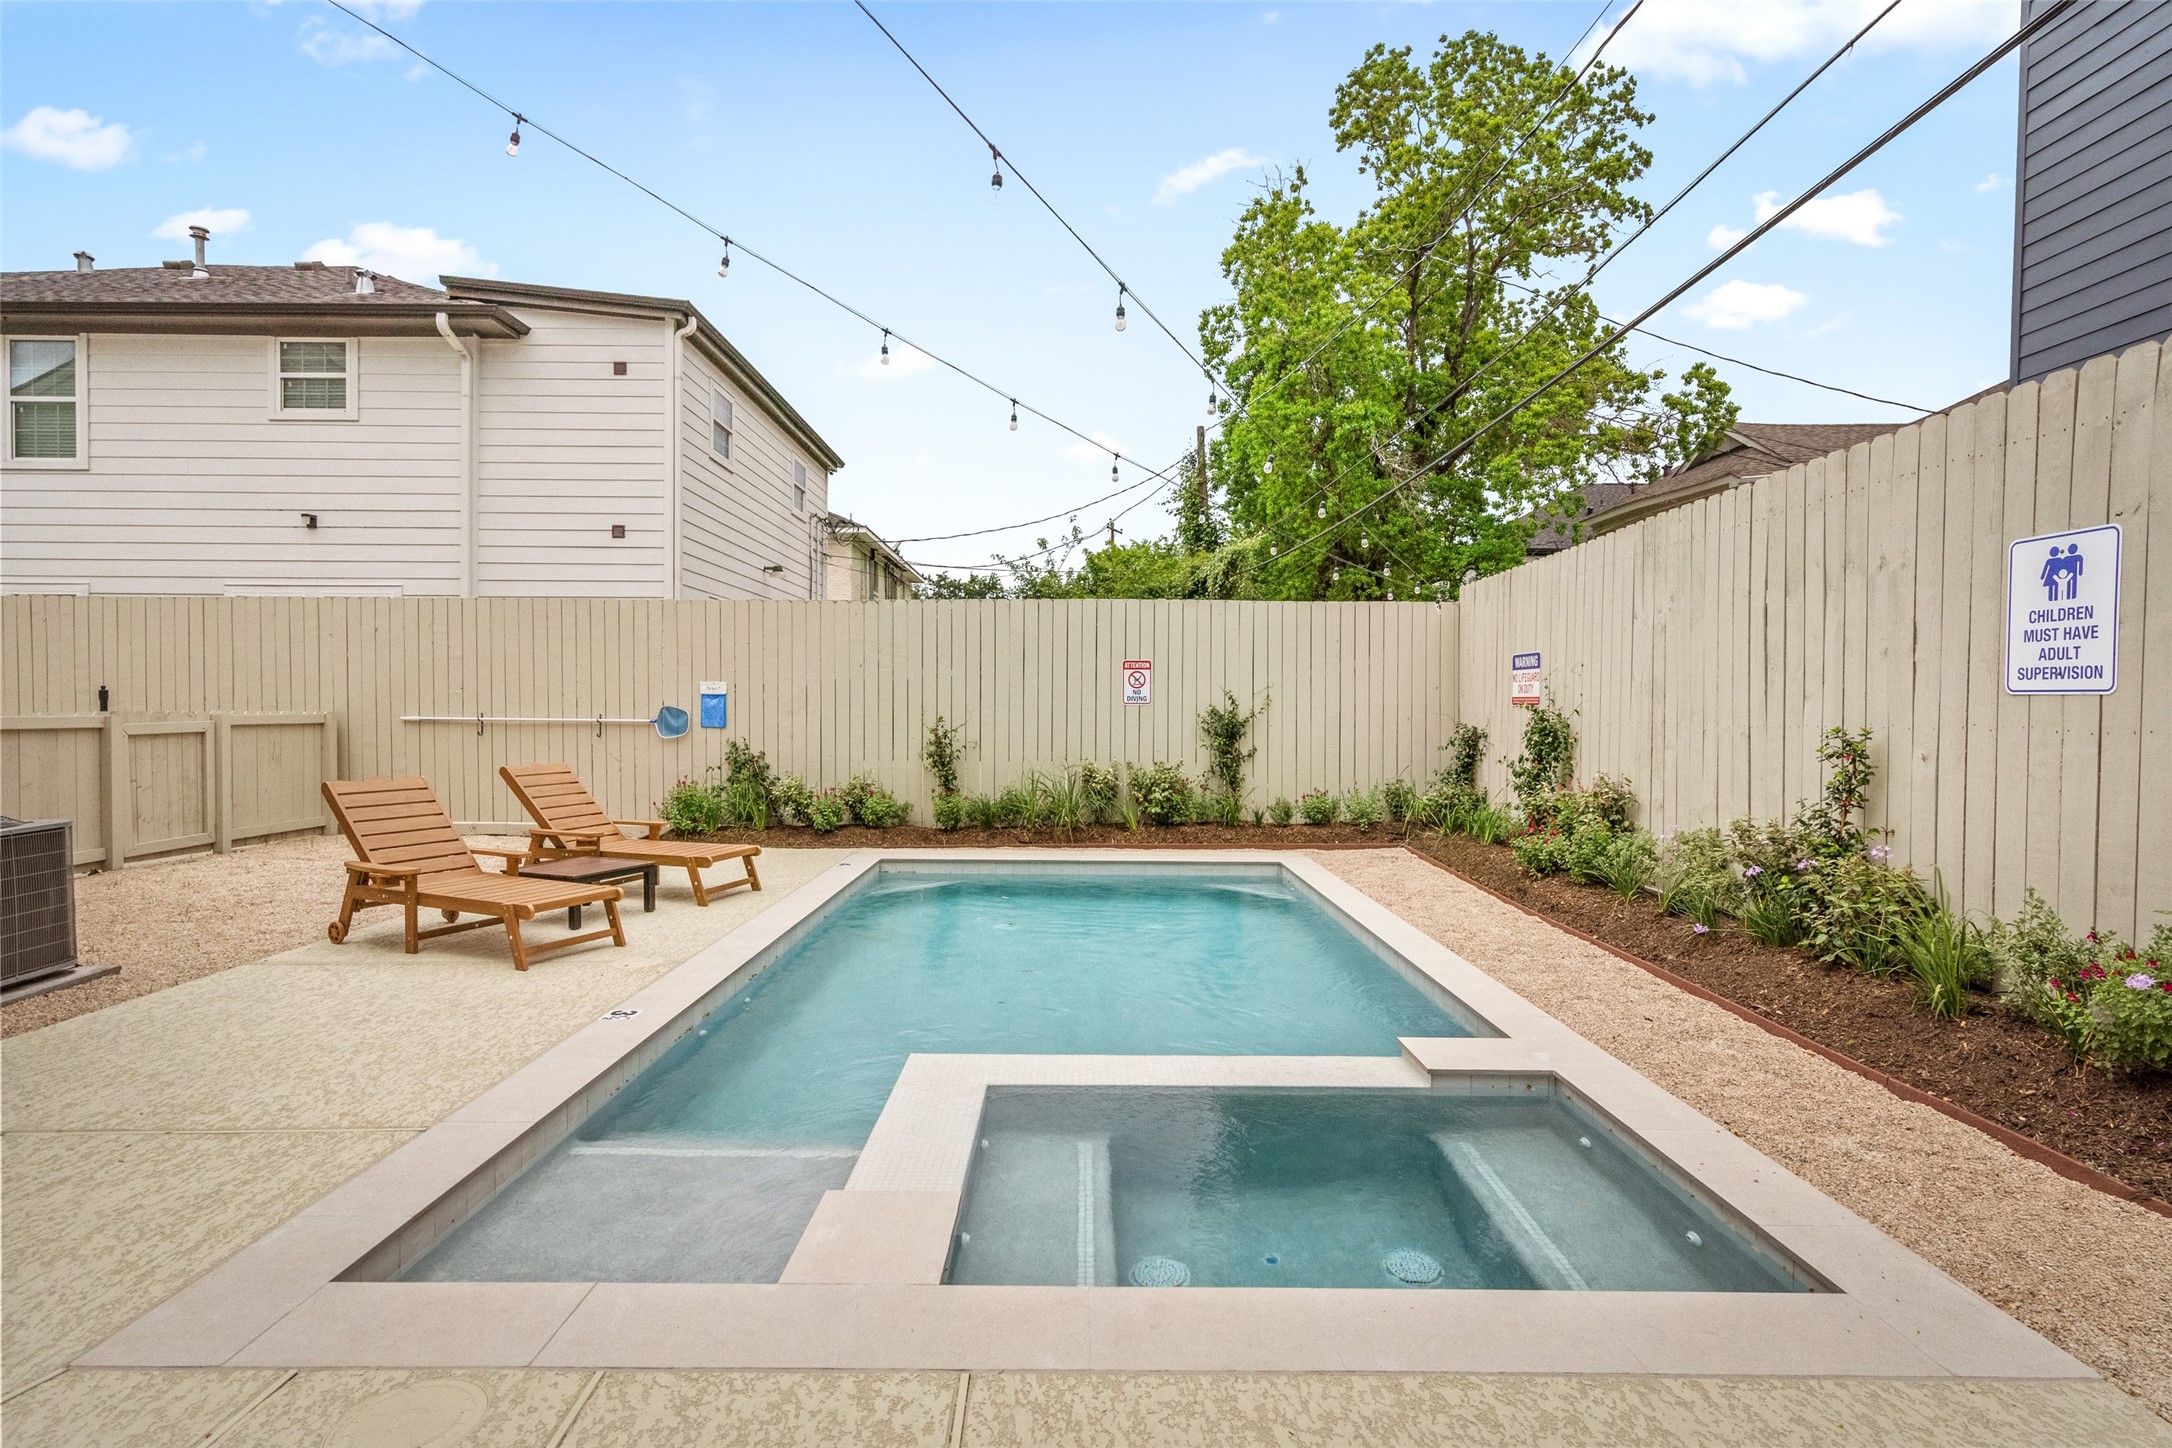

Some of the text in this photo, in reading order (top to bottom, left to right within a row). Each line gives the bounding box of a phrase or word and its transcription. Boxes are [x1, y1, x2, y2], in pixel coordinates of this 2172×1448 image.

[2028, 605, 2094, 624] CHILDREN
[2023, 625, 2099, 643] MUST HAVE
[1514, 655, 1538, 668] WARNING
[2038, 646, 2081, 661] ADULT
[2017, 665, 2104, 681] SUPERVISION
